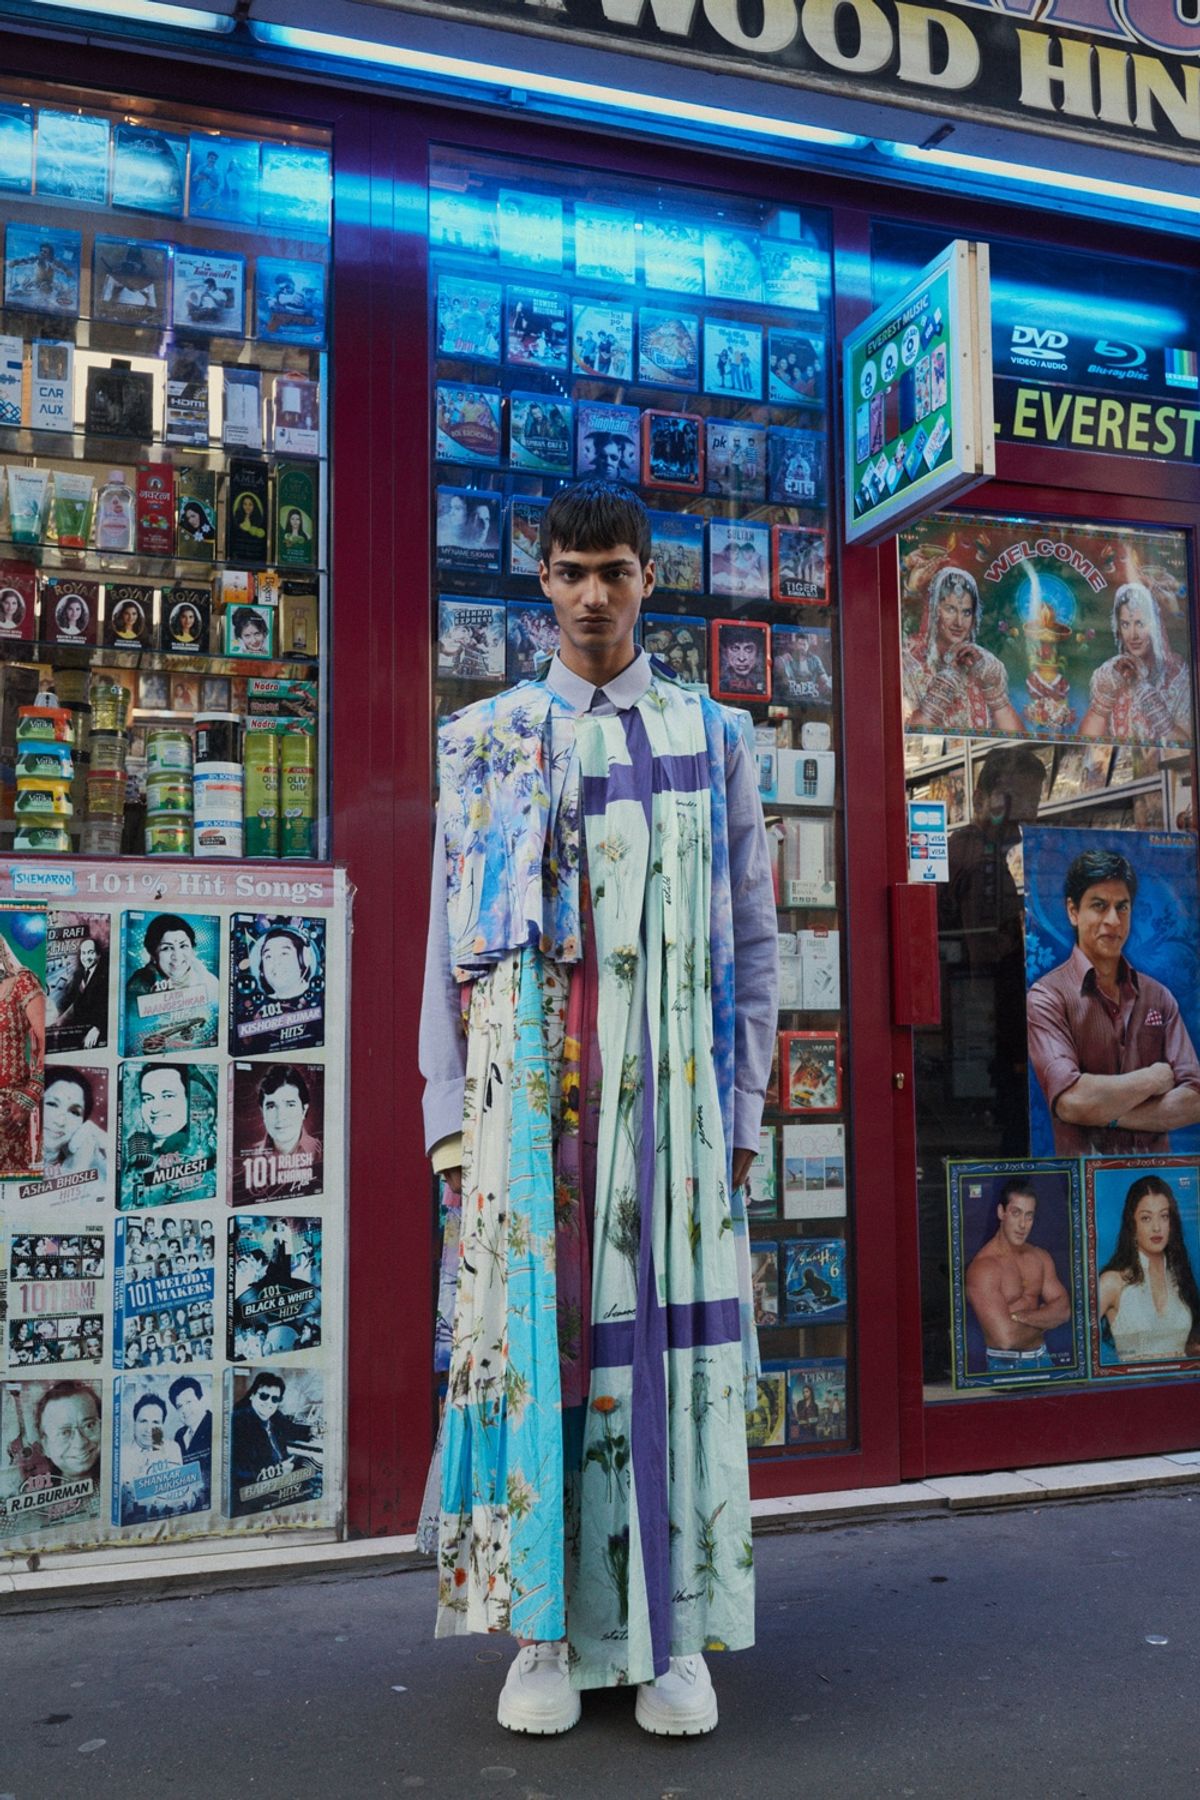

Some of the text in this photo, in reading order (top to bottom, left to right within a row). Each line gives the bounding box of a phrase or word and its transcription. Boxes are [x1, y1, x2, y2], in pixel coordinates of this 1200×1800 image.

[867, 317, 902, 355] EVEREST
[901, 294, 930, 326] MUSIC
[1011, 325, 1069, 348] DVD
[39, 387, 64, 399] CAR
[170, 397, 206, 409] HDMI
[1012, 387, 1200, 457] EVEREST
[712, 436, 728, 451] pk
[983, 538, 1108, 594] WELCOME
[54, 581, 97, 598] ROYAL
[109, 586, 153, 603] ROYAL
[785, 581, 817, 594] TIGER
[166, 591, 209, 606] ROYAL
[453, 609, 493, 618] CHENNAI
[913, 811, 942, 826] CB
[16, 872, 73, 887] SHEMAROO
[86, 873, 324, 904] 101% Hit Songs
[62, 926, 85, 938] RAFI
[154, 980, 173, 991] 101
[261, 1002, 283, 1018] 101
[240, 1007, 322, 1036] KISHORE KUMAR
[280, 1024, 305, 1039] HITS
[278, 1152, 314, 1169] RAJESH
[152, 1159, 208, 1185] MUKESH
[242, 1156, 277, 1189] 101
[21, 1170, 97, 1198] ASHA BHOSLE
[830, 1264, 840, 1278] 6
[155, 1271, 210, 1290] MELODY
[19, 1283, 57, 1313] 101
[61, 1281, 97, 1299] FILMI
[128, 1282, 153, 1308] 101
[156, 1282, 213, 1302] MAKERS
[263, 1285, 281, 1299] 101
[244, 1288, 314, 1316] BLACK & WHITE
[279, 1304, 299, 1319] HITS
[138, 1469, 182, 1489] SHANKAR
[261, 1462, 283, 1481] 101
[28, 1472, 54, 1491] 101
[153, 1474, 198, 1493] JAIKISHAN
[245, 1479, 278, 1499] BAPPI
[10, 1481, 91, 1513] R.D.BURMAN
[278, 1483, 302, 1499] HITS
